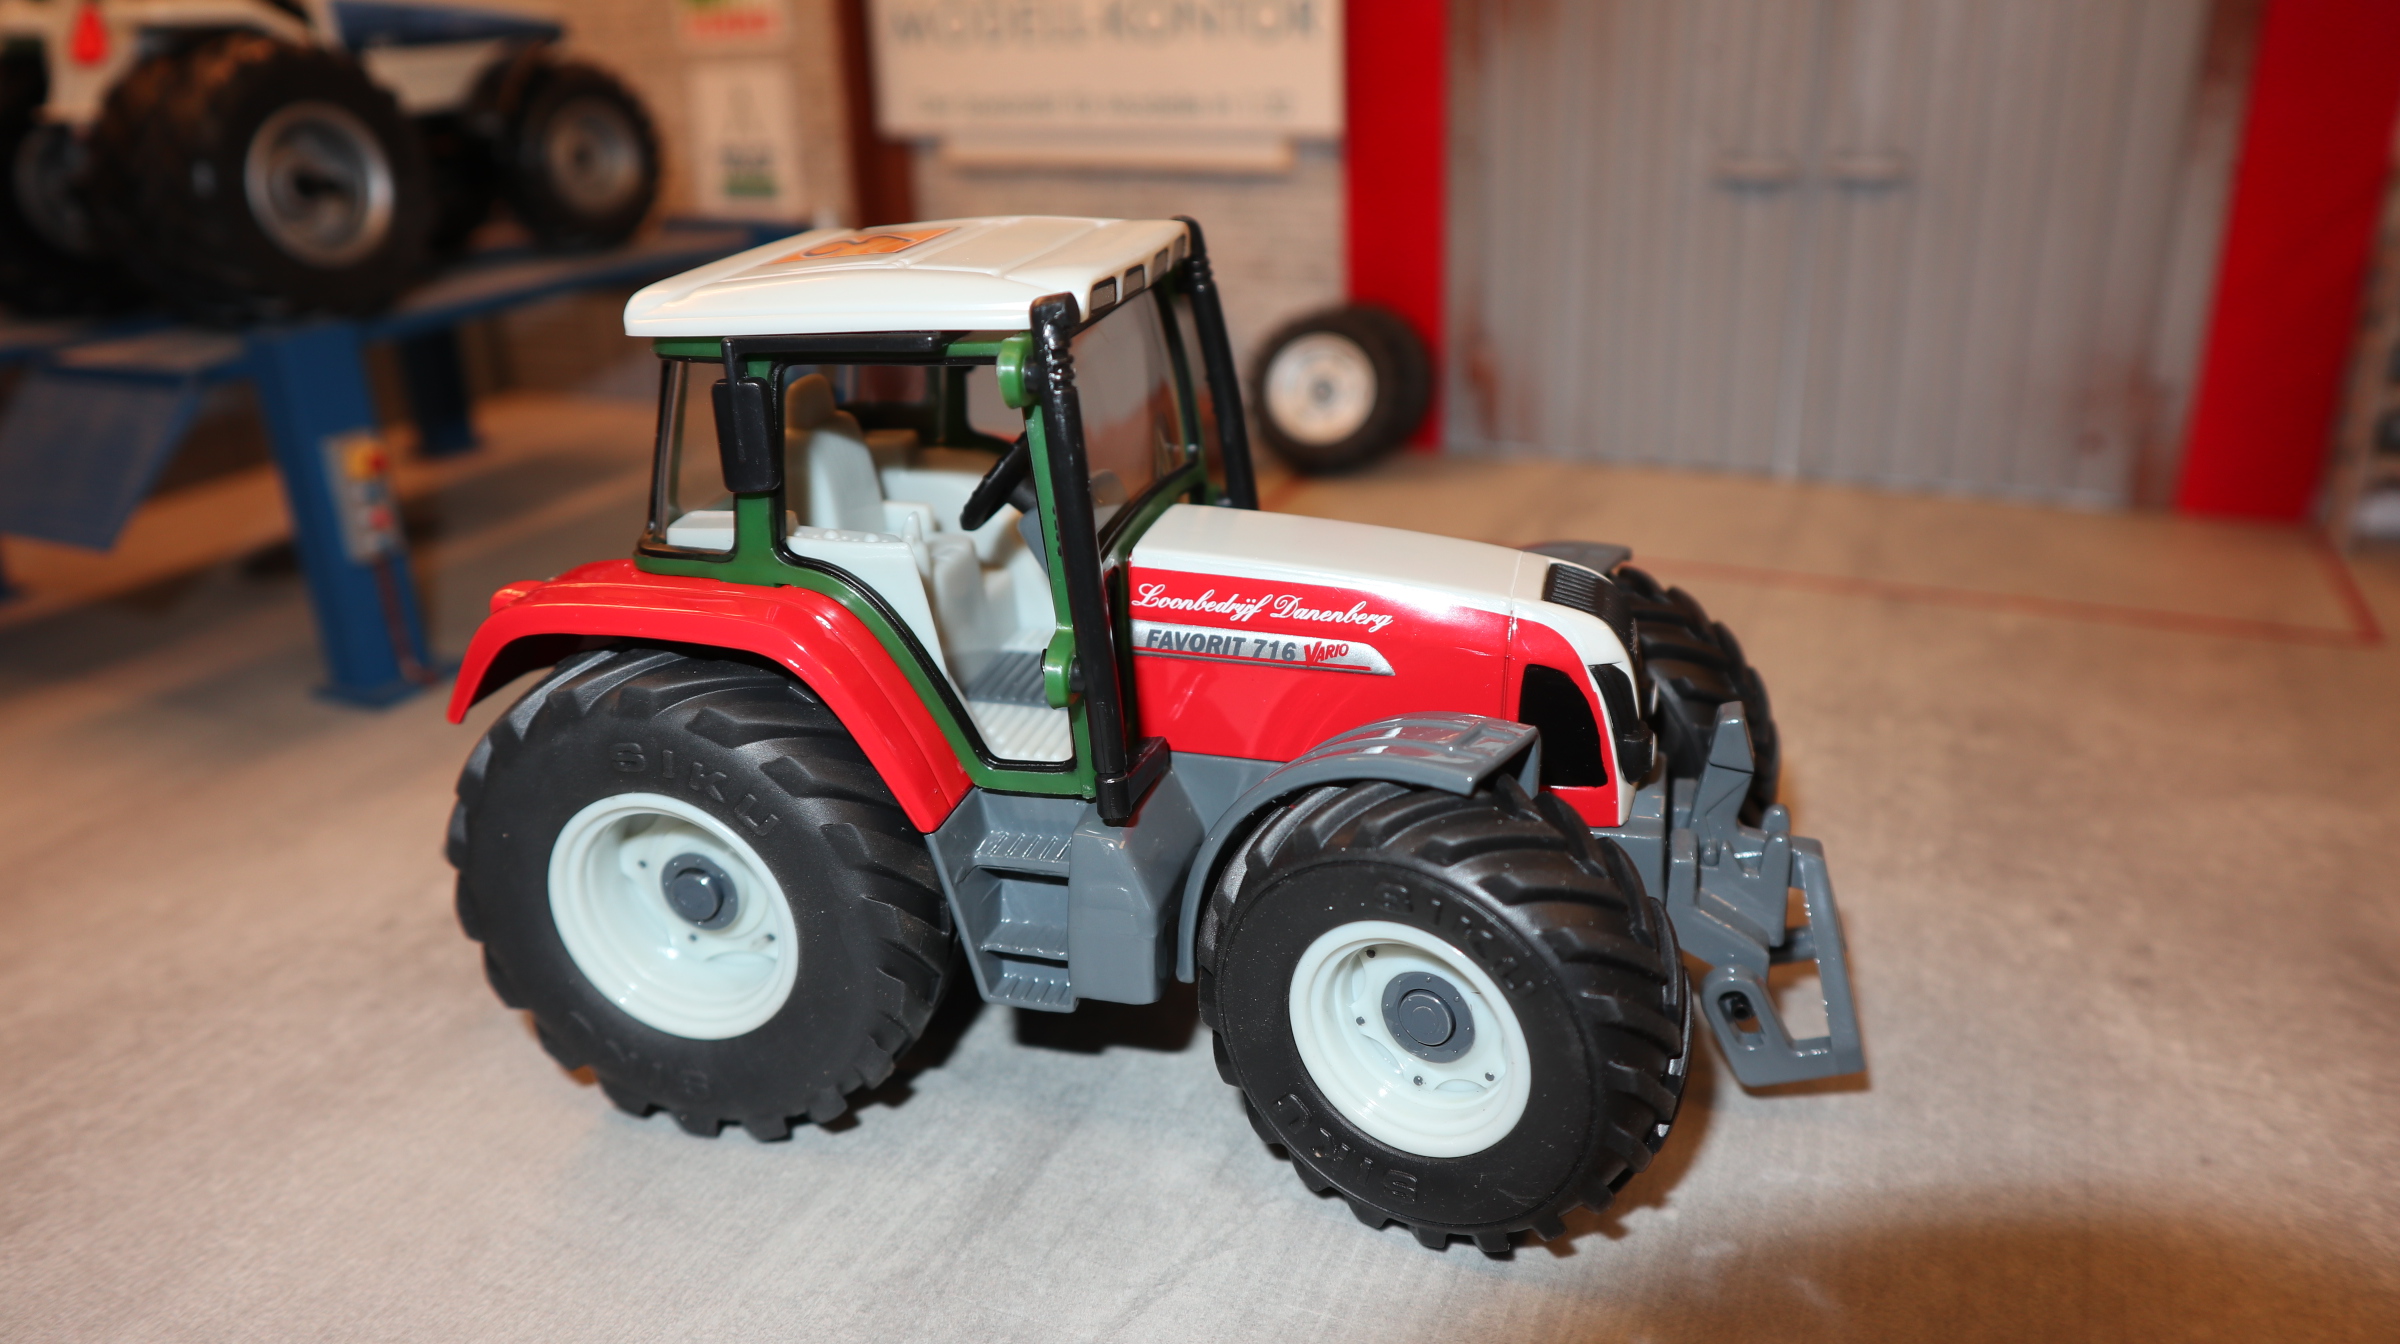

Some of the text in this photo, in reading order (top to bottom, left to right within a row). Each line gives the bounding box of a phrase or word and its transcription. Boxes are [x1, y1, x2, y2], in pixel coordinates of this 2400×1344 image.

[1270, 594, 1393, 633] Danenberg
[1146, 629, 1349, 666] FAVORIT 716 VARIO
[611, 742, 780, 837] SIKU
